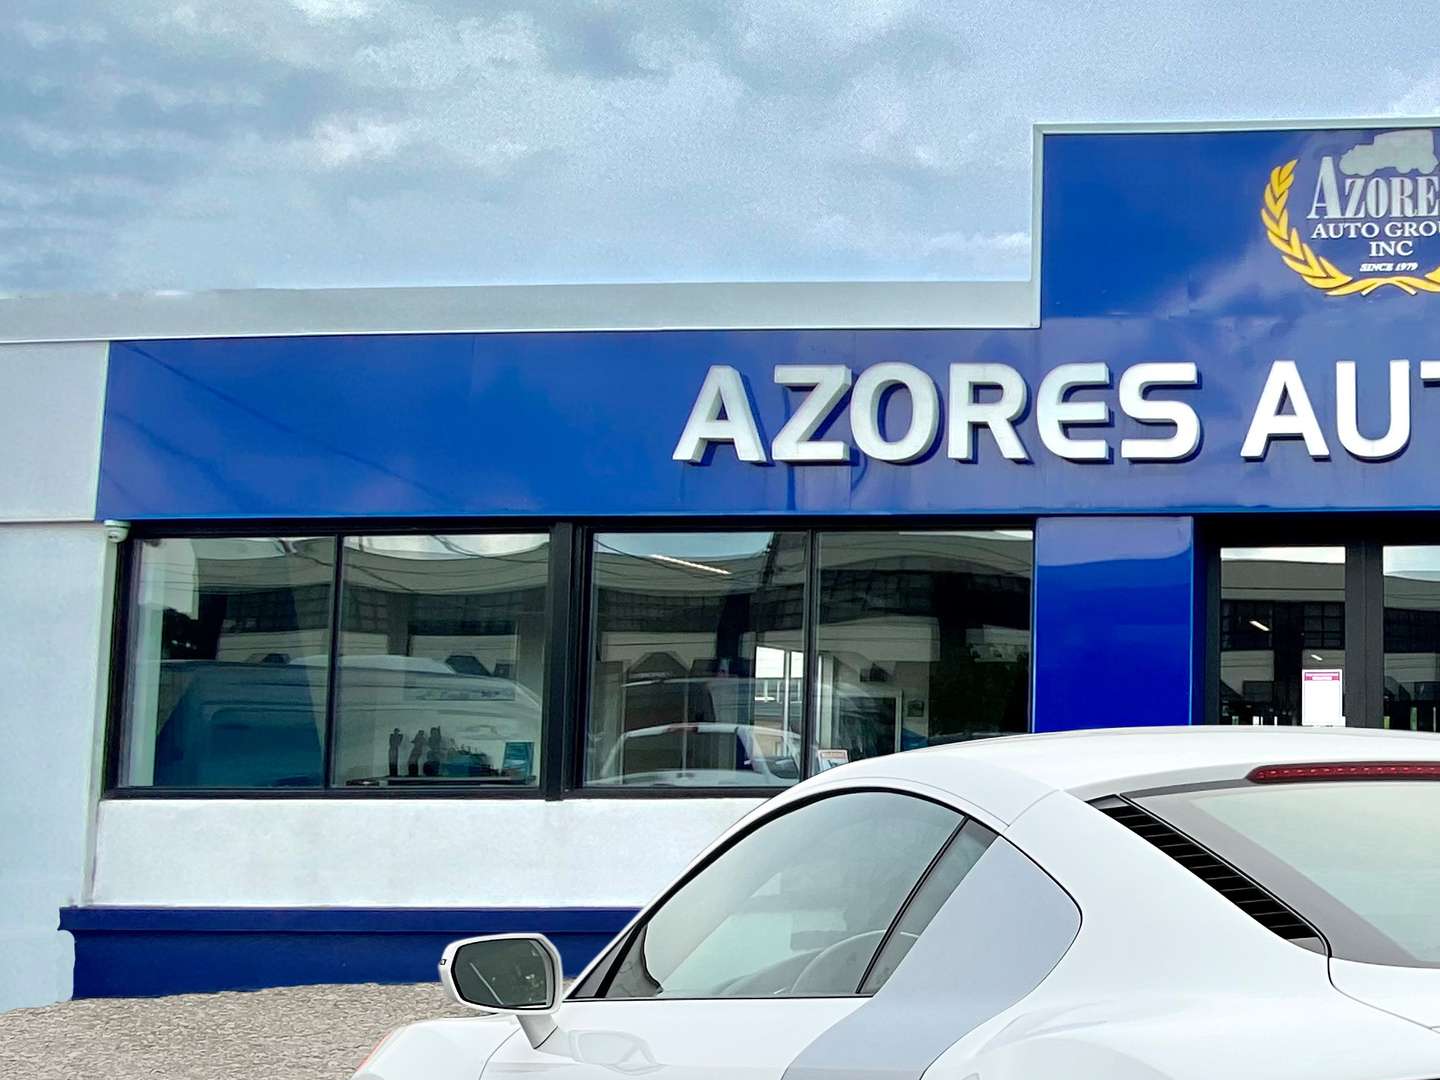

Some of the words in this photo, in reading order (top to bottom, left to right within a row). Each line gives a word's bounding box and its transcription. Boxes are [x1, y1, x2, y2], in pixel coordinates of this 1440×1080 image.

[1311, 222, 1380, 239] AUTO
[1368, 241, 1413, 257] INC
[1360, 263, 1394, 272] SINCE
[1395, 262, 1418, 271] 1979
[672, 360, 1201, 465] AZORES
